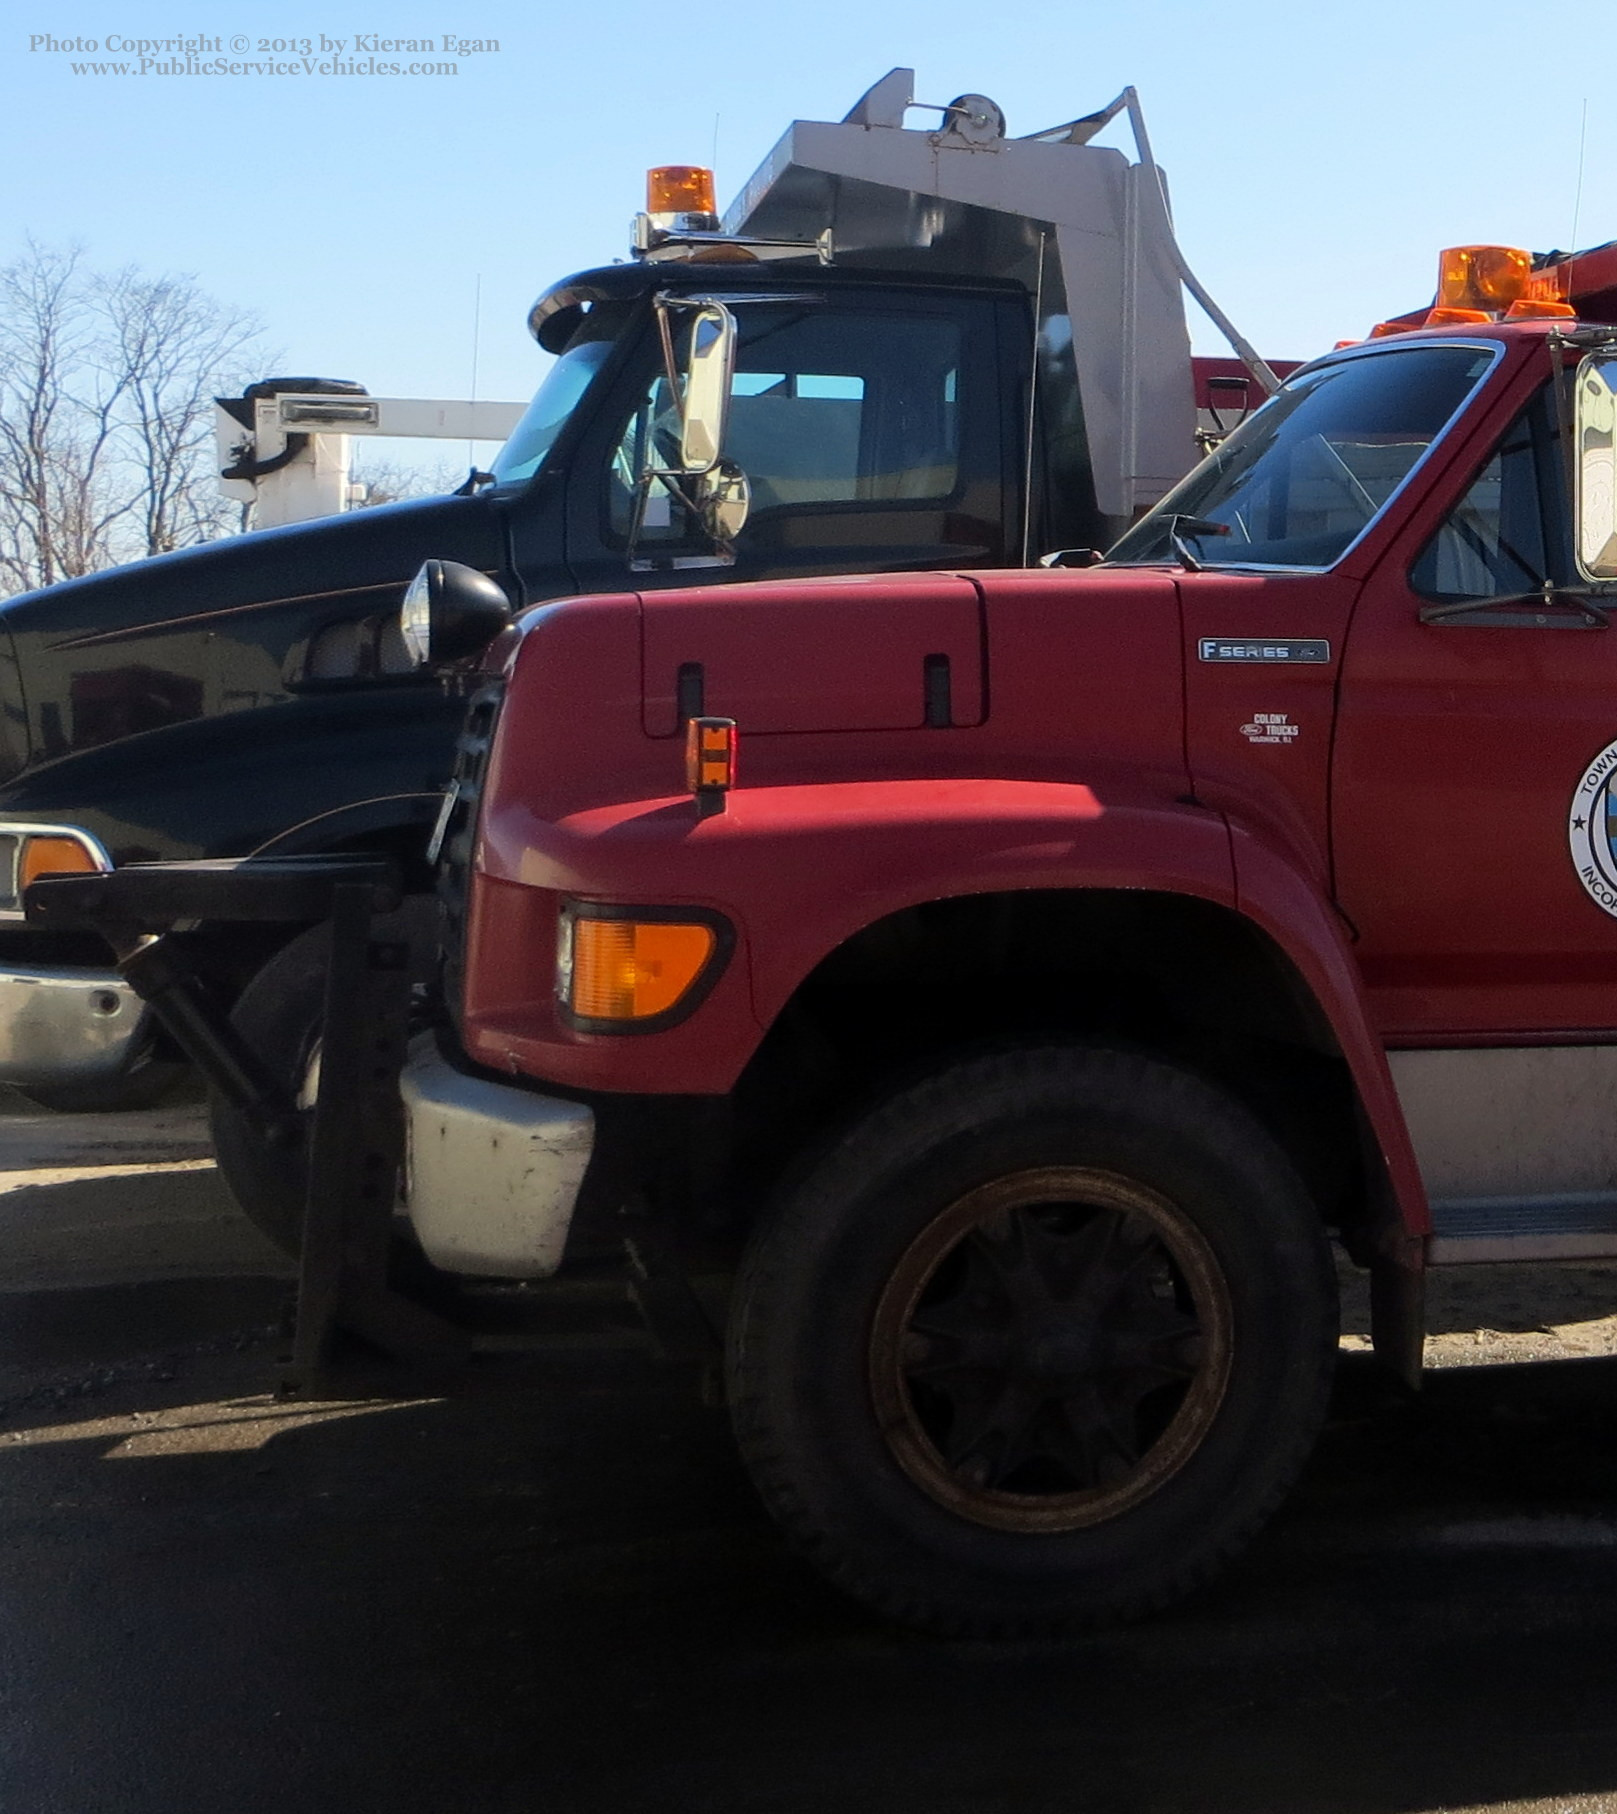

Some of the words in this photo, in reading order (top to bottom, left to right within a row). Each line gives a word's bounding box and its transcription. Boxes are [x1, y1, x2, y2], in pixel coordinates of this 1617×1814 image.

[1203, 642, 1216, 658] F
[1219, 645, 1289, 658] SERIES
[1254, 713, 1288, 724] COLONY
[1266, 725, 1299, 736] TRUCKS
